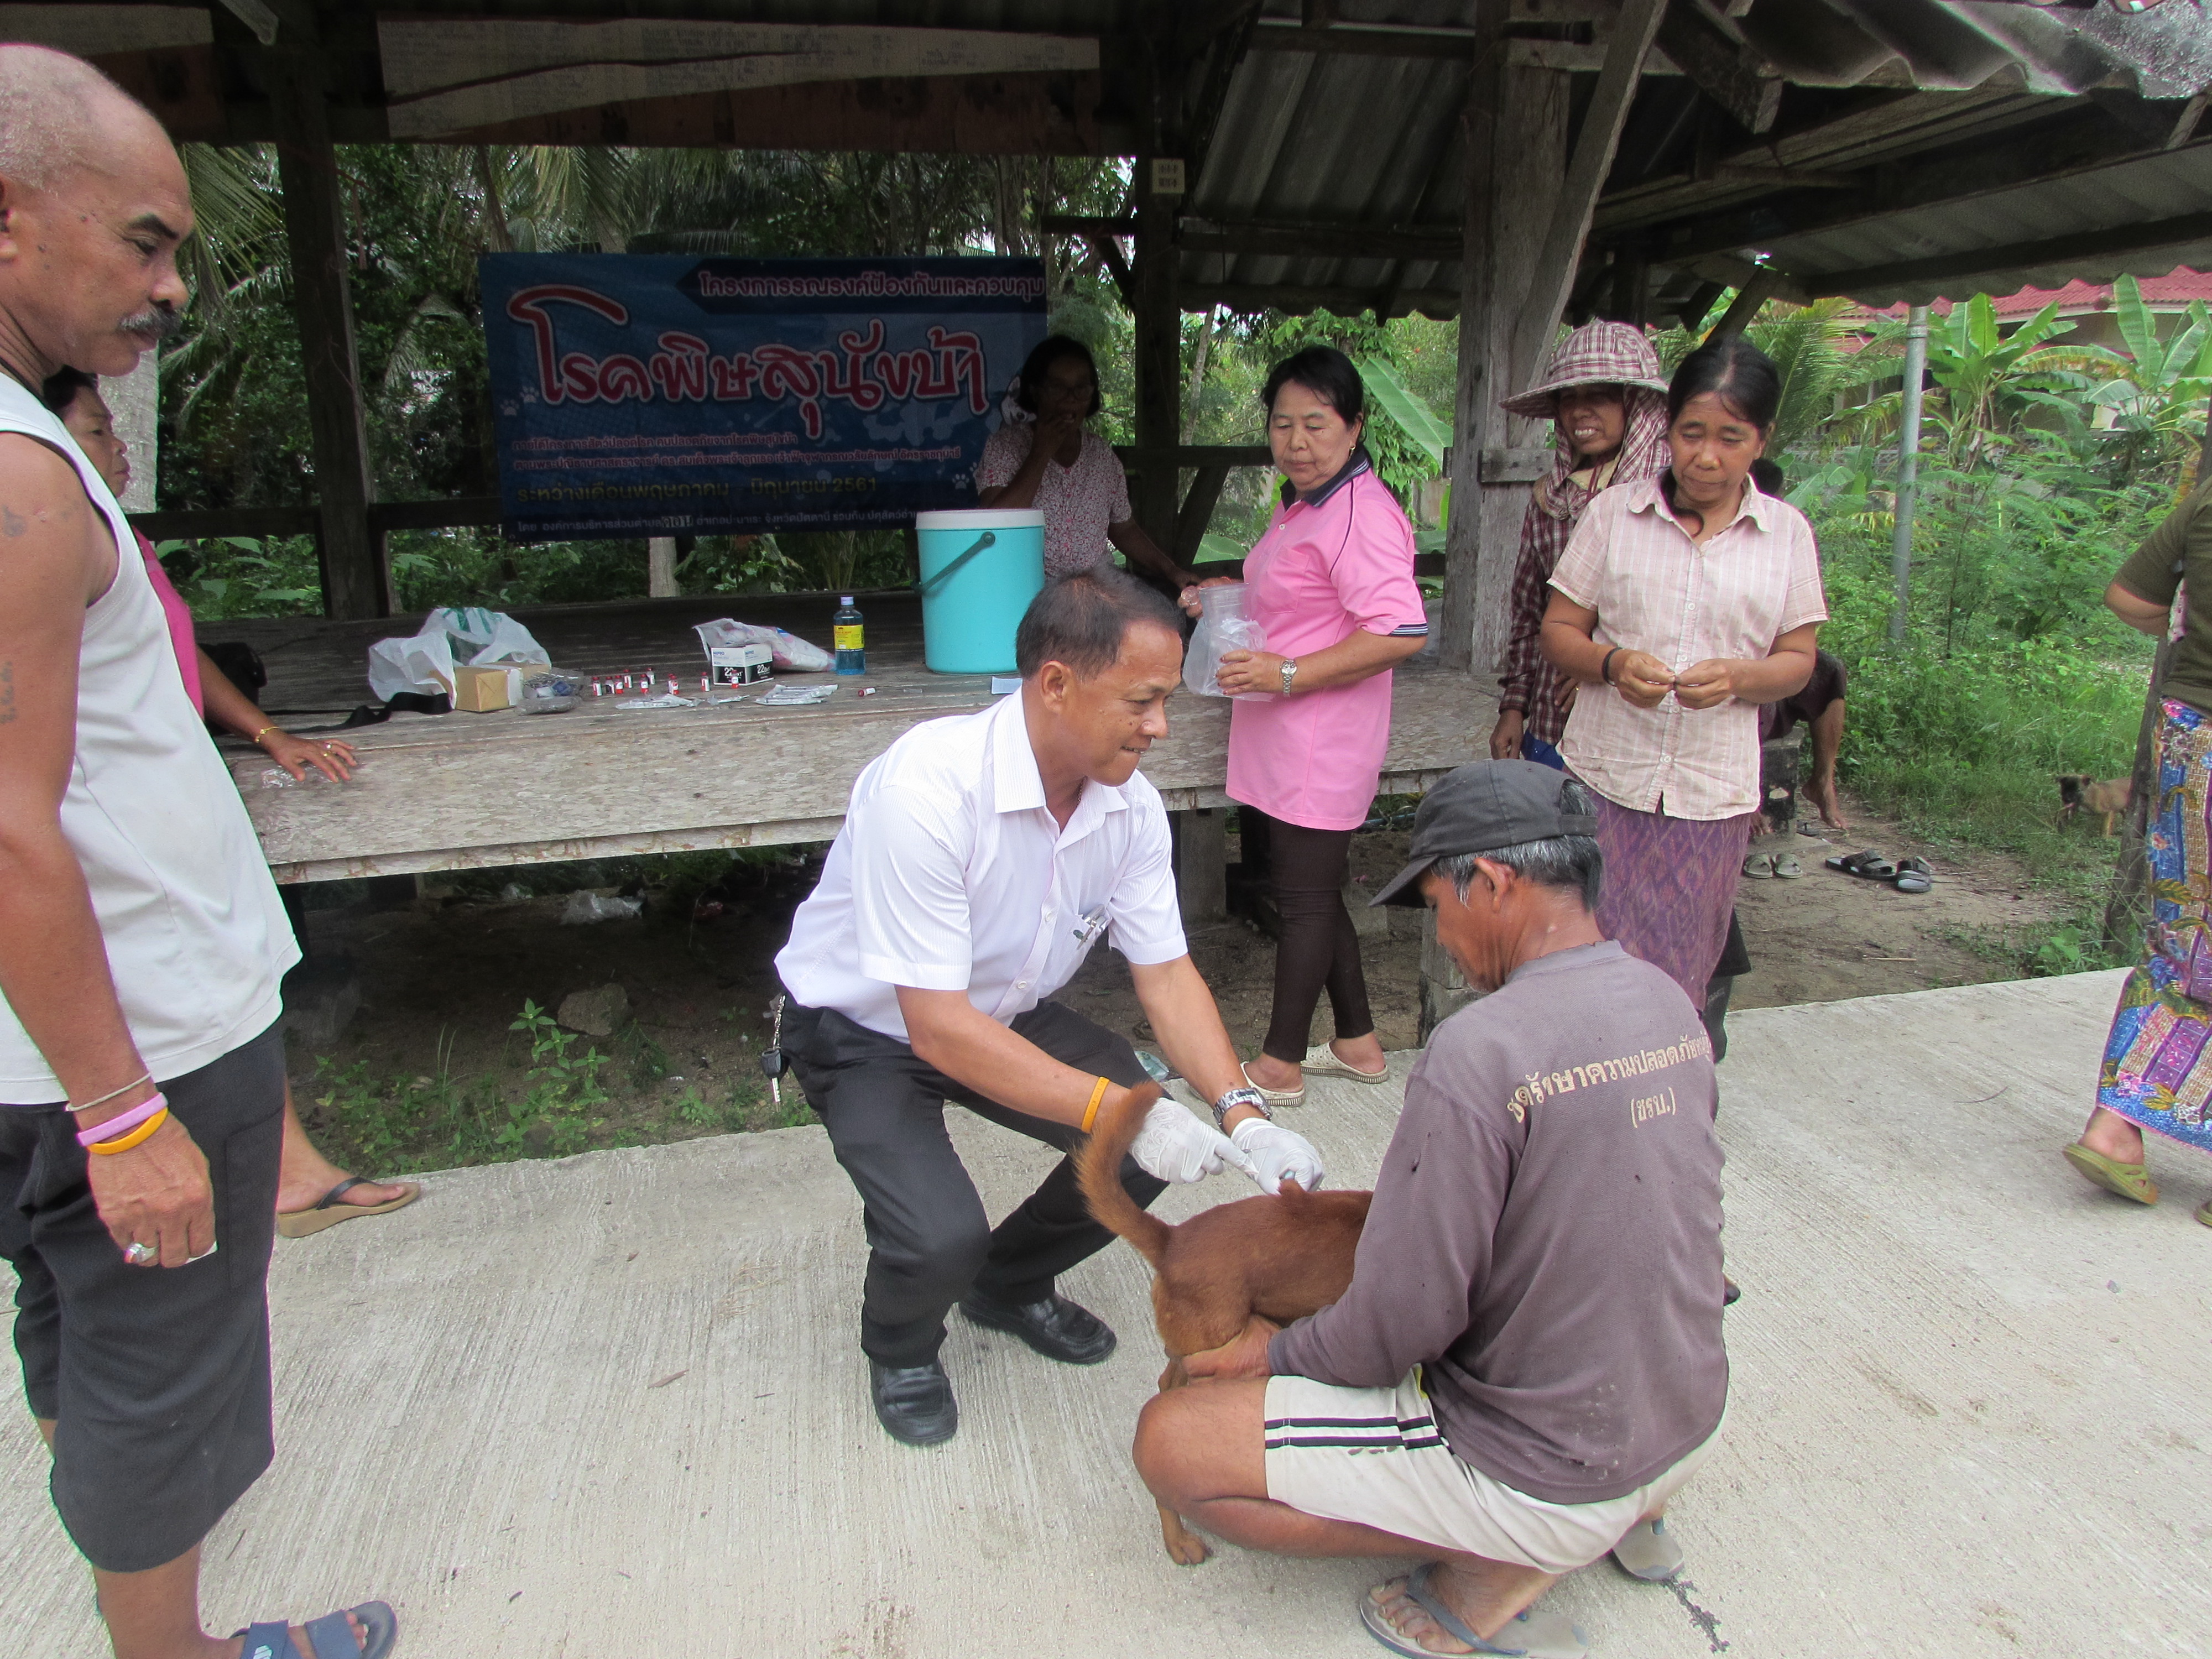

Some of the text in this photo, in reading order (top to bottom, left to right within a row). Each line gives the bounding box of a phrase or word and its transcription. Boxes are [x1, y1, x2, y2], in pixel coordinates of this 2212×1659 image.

[506, 284, 991, 439] โรคพิษสุนัขบ้า
[517, 476, 877, 503] ระหว่างเดือนพฤษภาคม มิถุนายน 2561
[518, 521, 537, 533] โดย
[1631, 1087, 1676, 1128] (ชรบ.)
